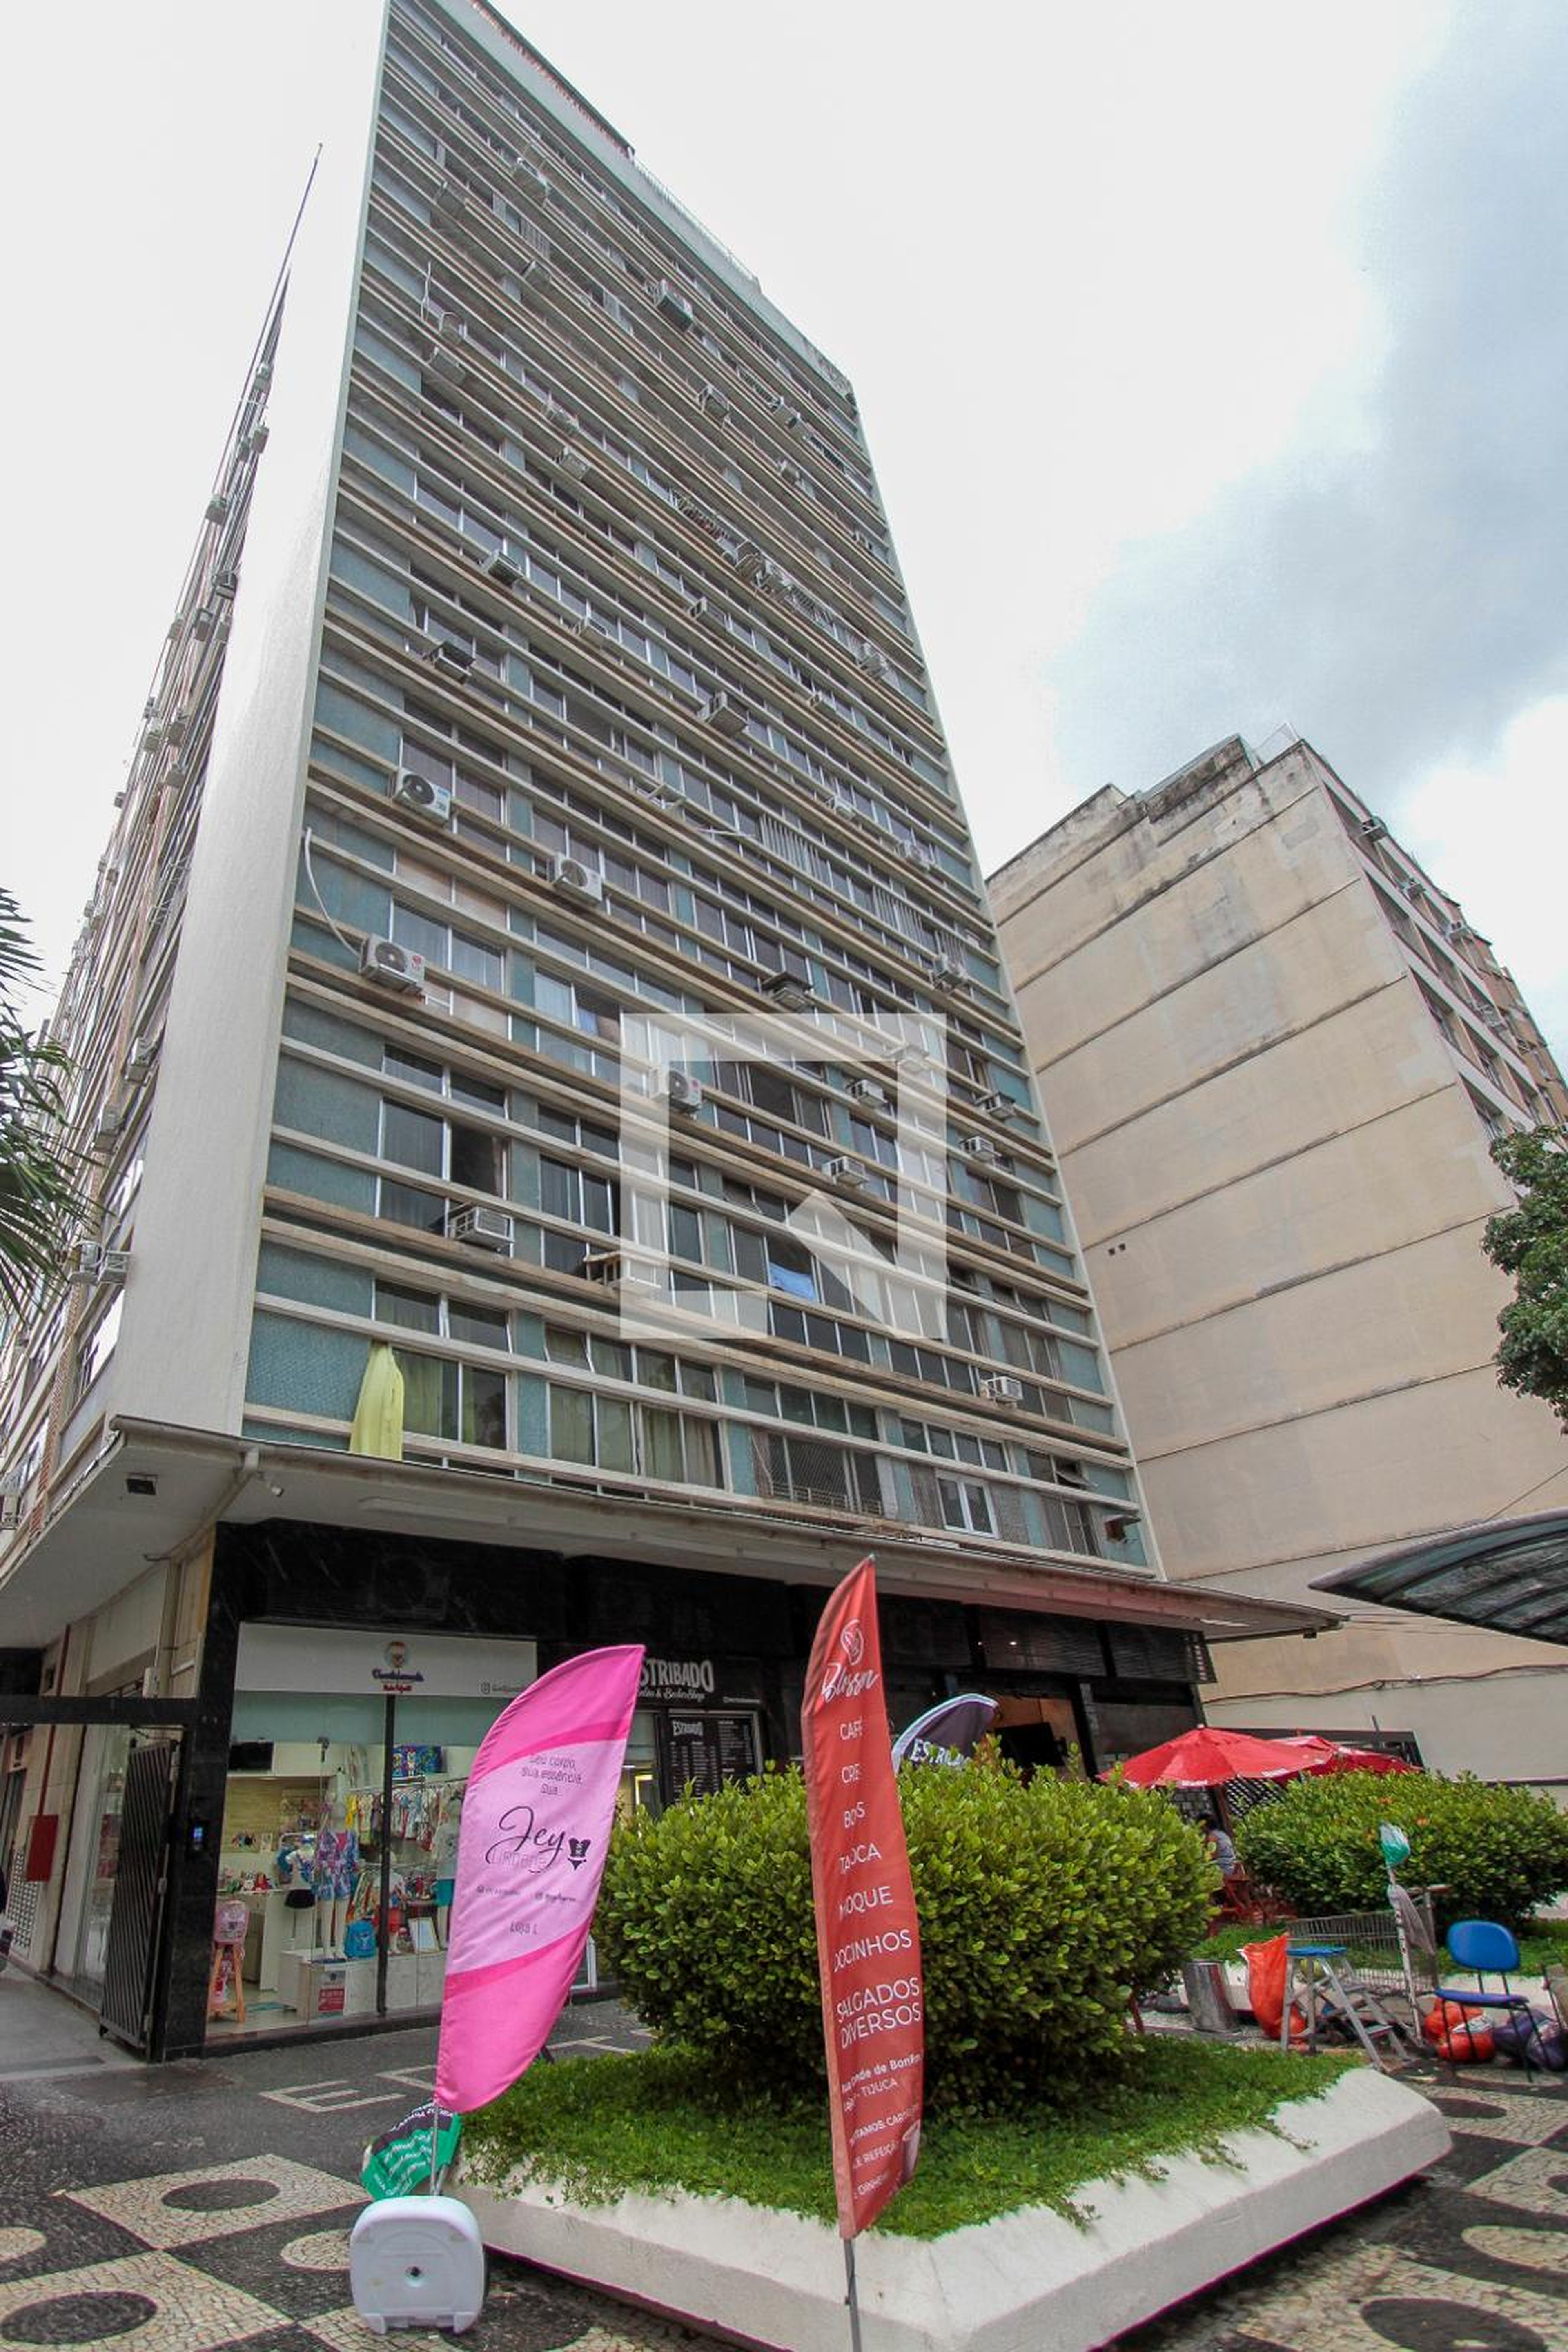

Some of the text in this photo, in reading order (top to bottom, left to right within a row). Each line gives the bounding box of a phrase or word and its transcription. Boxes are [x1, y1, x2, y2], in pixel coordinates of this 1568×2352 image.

[640, 1658, 714, 1693] STRIBADO
[485, 1806, 566, 1873] Jey
[834, 1929, 912, 1973] DOCINHOS
[837, 1977, 920, 2024] SALGADOS
[840, 2002, 921, 2049] DIVERSOS
